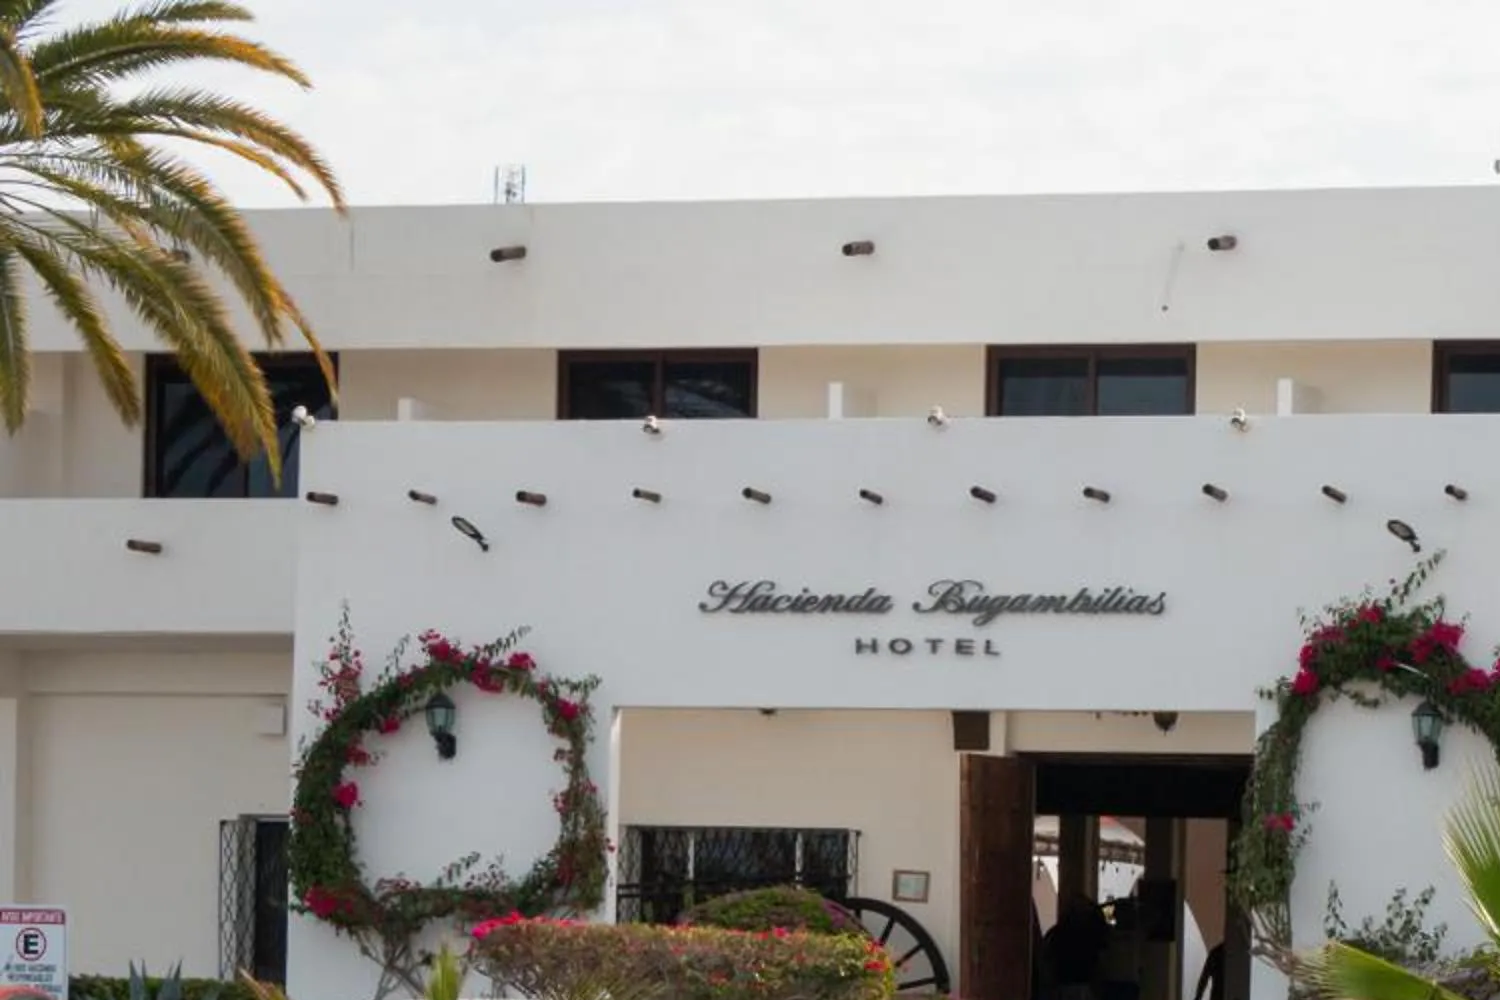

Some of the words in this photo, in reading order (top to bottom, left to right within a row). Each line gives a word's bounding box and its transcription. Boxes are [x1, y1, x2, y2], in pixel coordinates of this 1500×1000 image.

[698, 580, 894, 614] Hacienda
[912, 579, 1166, 627] Bugambilias
[855, 637, 1001, 656] HOTEL
[23, 933, 39, 955] E
